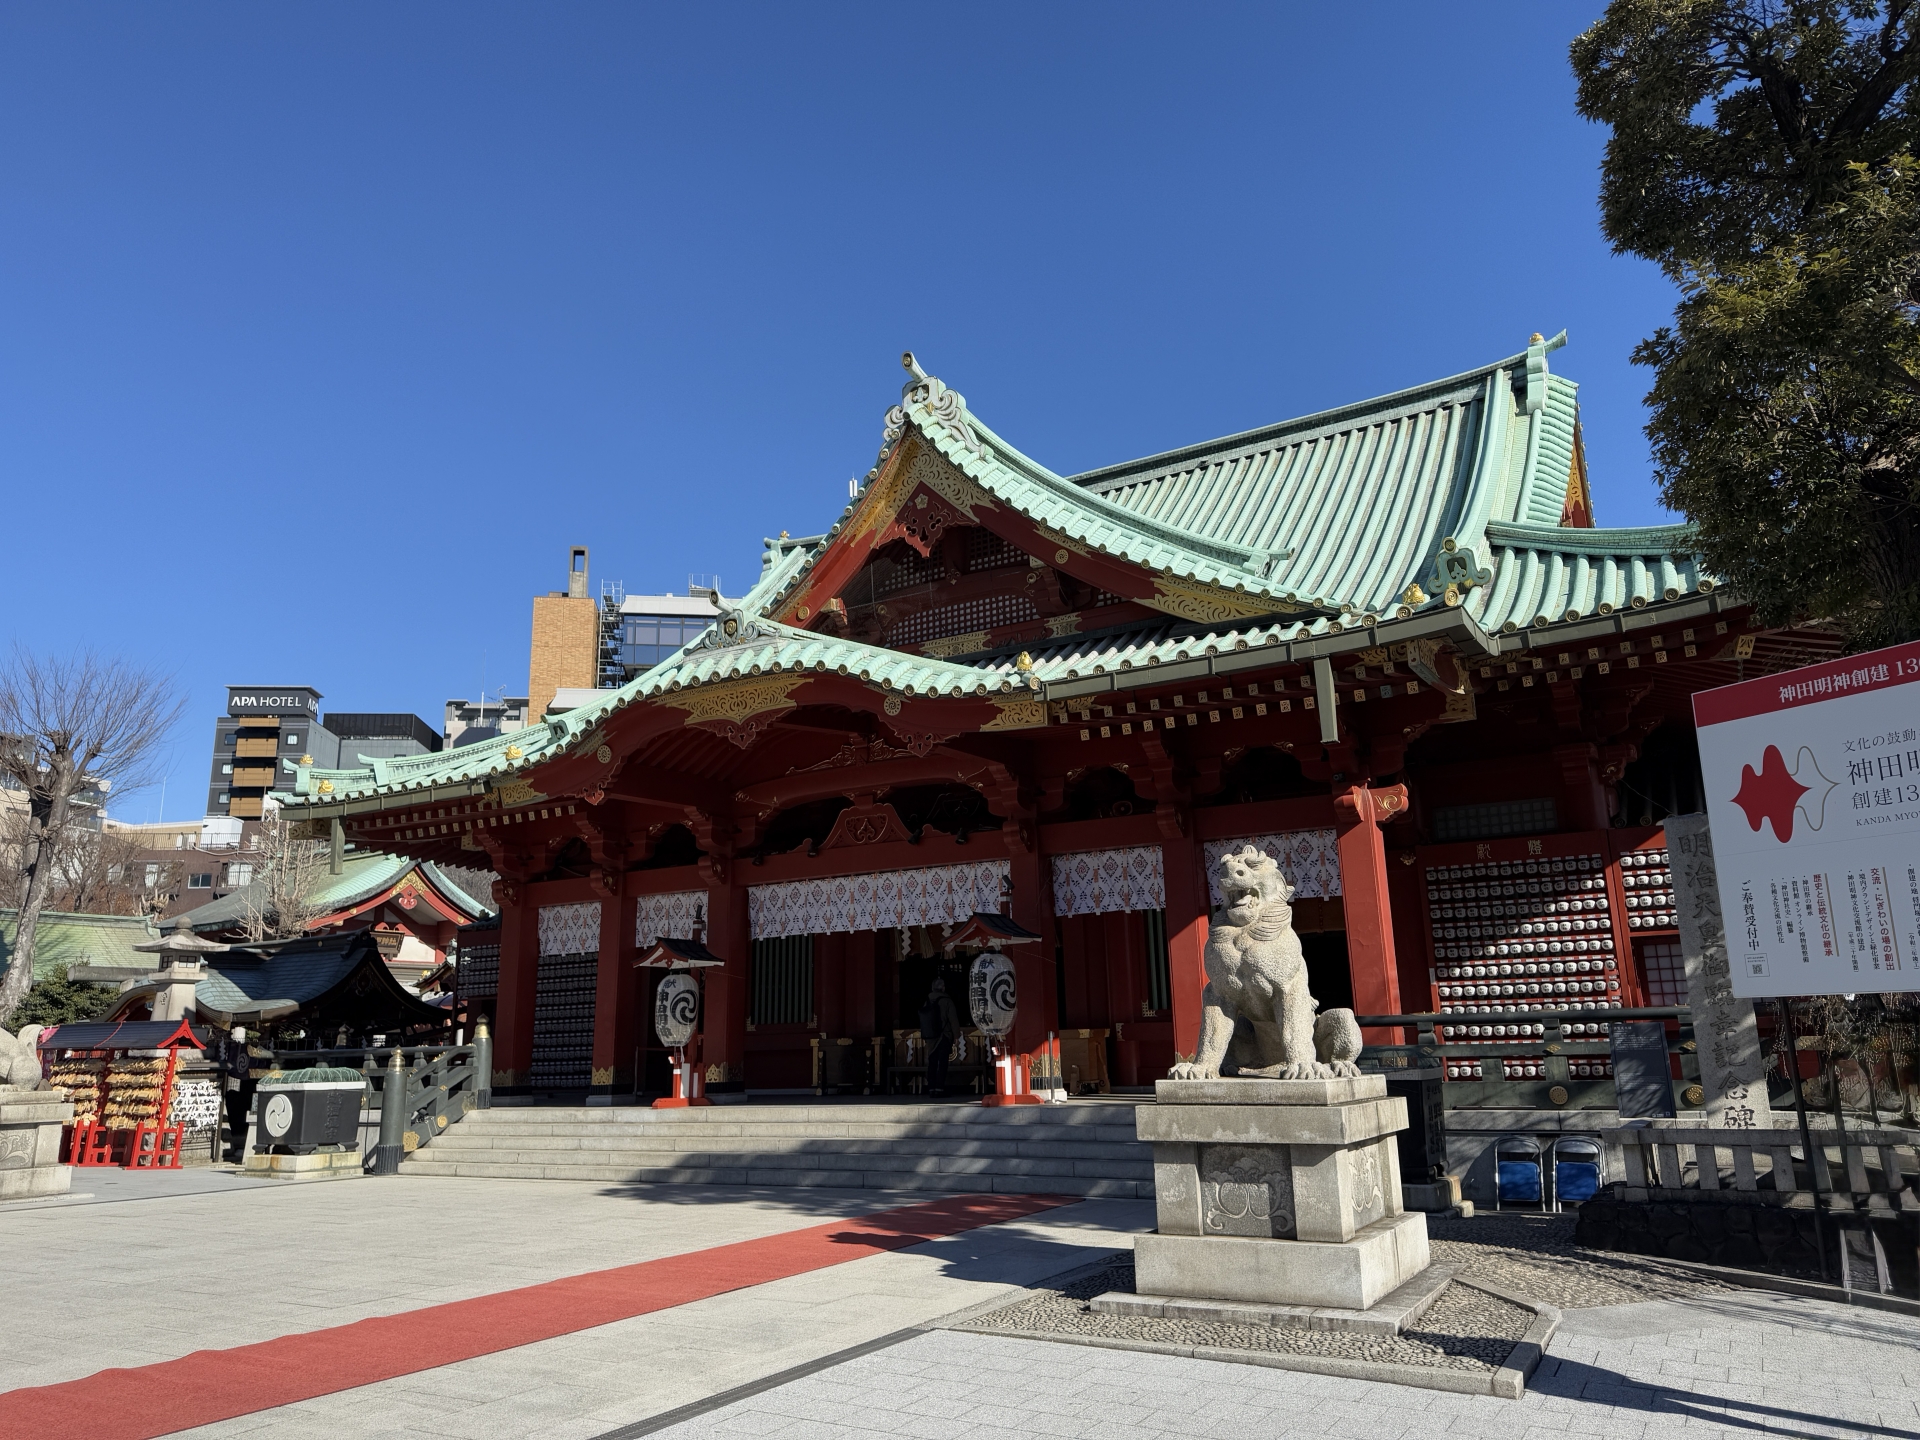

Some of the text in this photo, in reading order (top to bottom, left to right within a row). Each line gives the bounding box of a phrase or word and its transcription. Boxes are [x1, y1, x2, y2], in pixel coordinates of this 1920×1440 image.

[1779, 657, 1920, 704] 神田明神創建 13
[231, 696, 302, 707] APA HOTEL
[1842, 728, 1920, 754] 文化の鼓動
[1852, 784, 1920, 810] 創建13
[1856, 810, 1920, 827] KANDA MYO
[1741, 879, 1760, 951] ご奉賛受付中
[1813, 873, 1834, 957] 歴史と伝統文化の継承
[1870, 868, 1895, 971] 交流・にぎわいの場の創出
